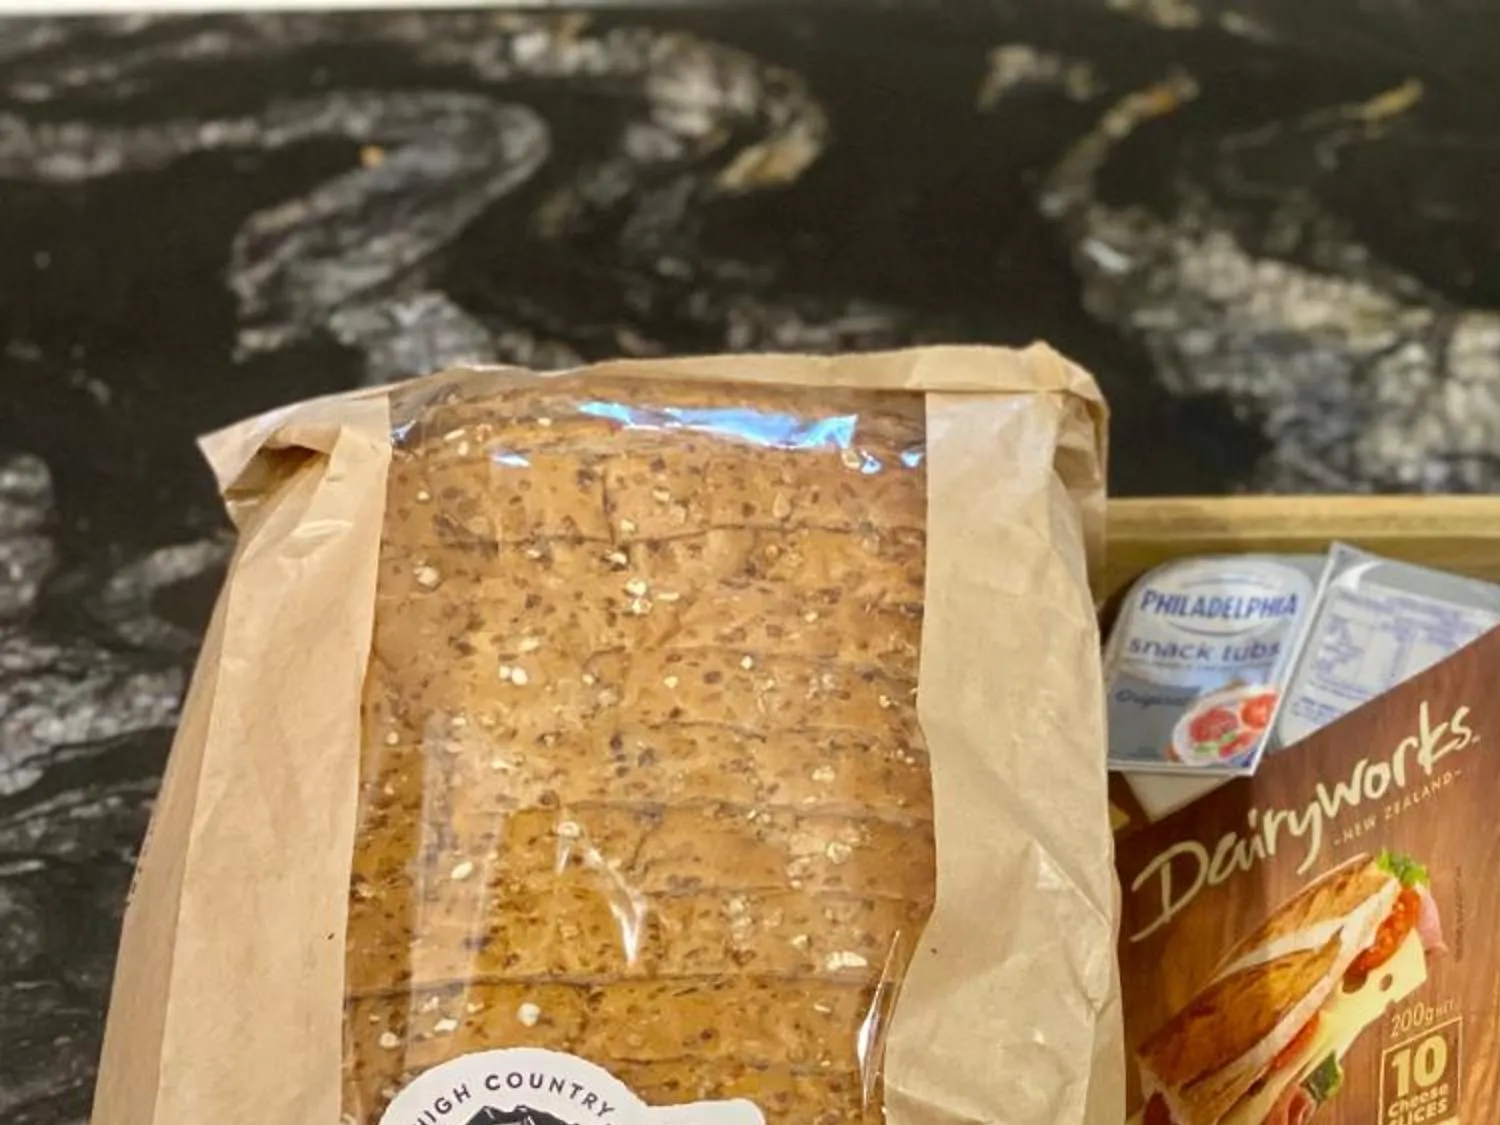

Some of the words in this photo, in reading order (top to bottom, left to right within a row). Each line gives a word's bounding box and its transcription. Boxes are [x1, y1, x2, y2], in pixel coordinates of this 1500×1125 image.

[1140, 589, 1298, 619] PHILADELPHIA
[1130, 639, 1210, 661] snack
[1223, 641, 1282, 662] tubs
[1131, 701, 1473, 941] Dairyworks
[1390, 1034, 1448, 1098] 10
[484, 1071, 616, 1118] COUNTRY
